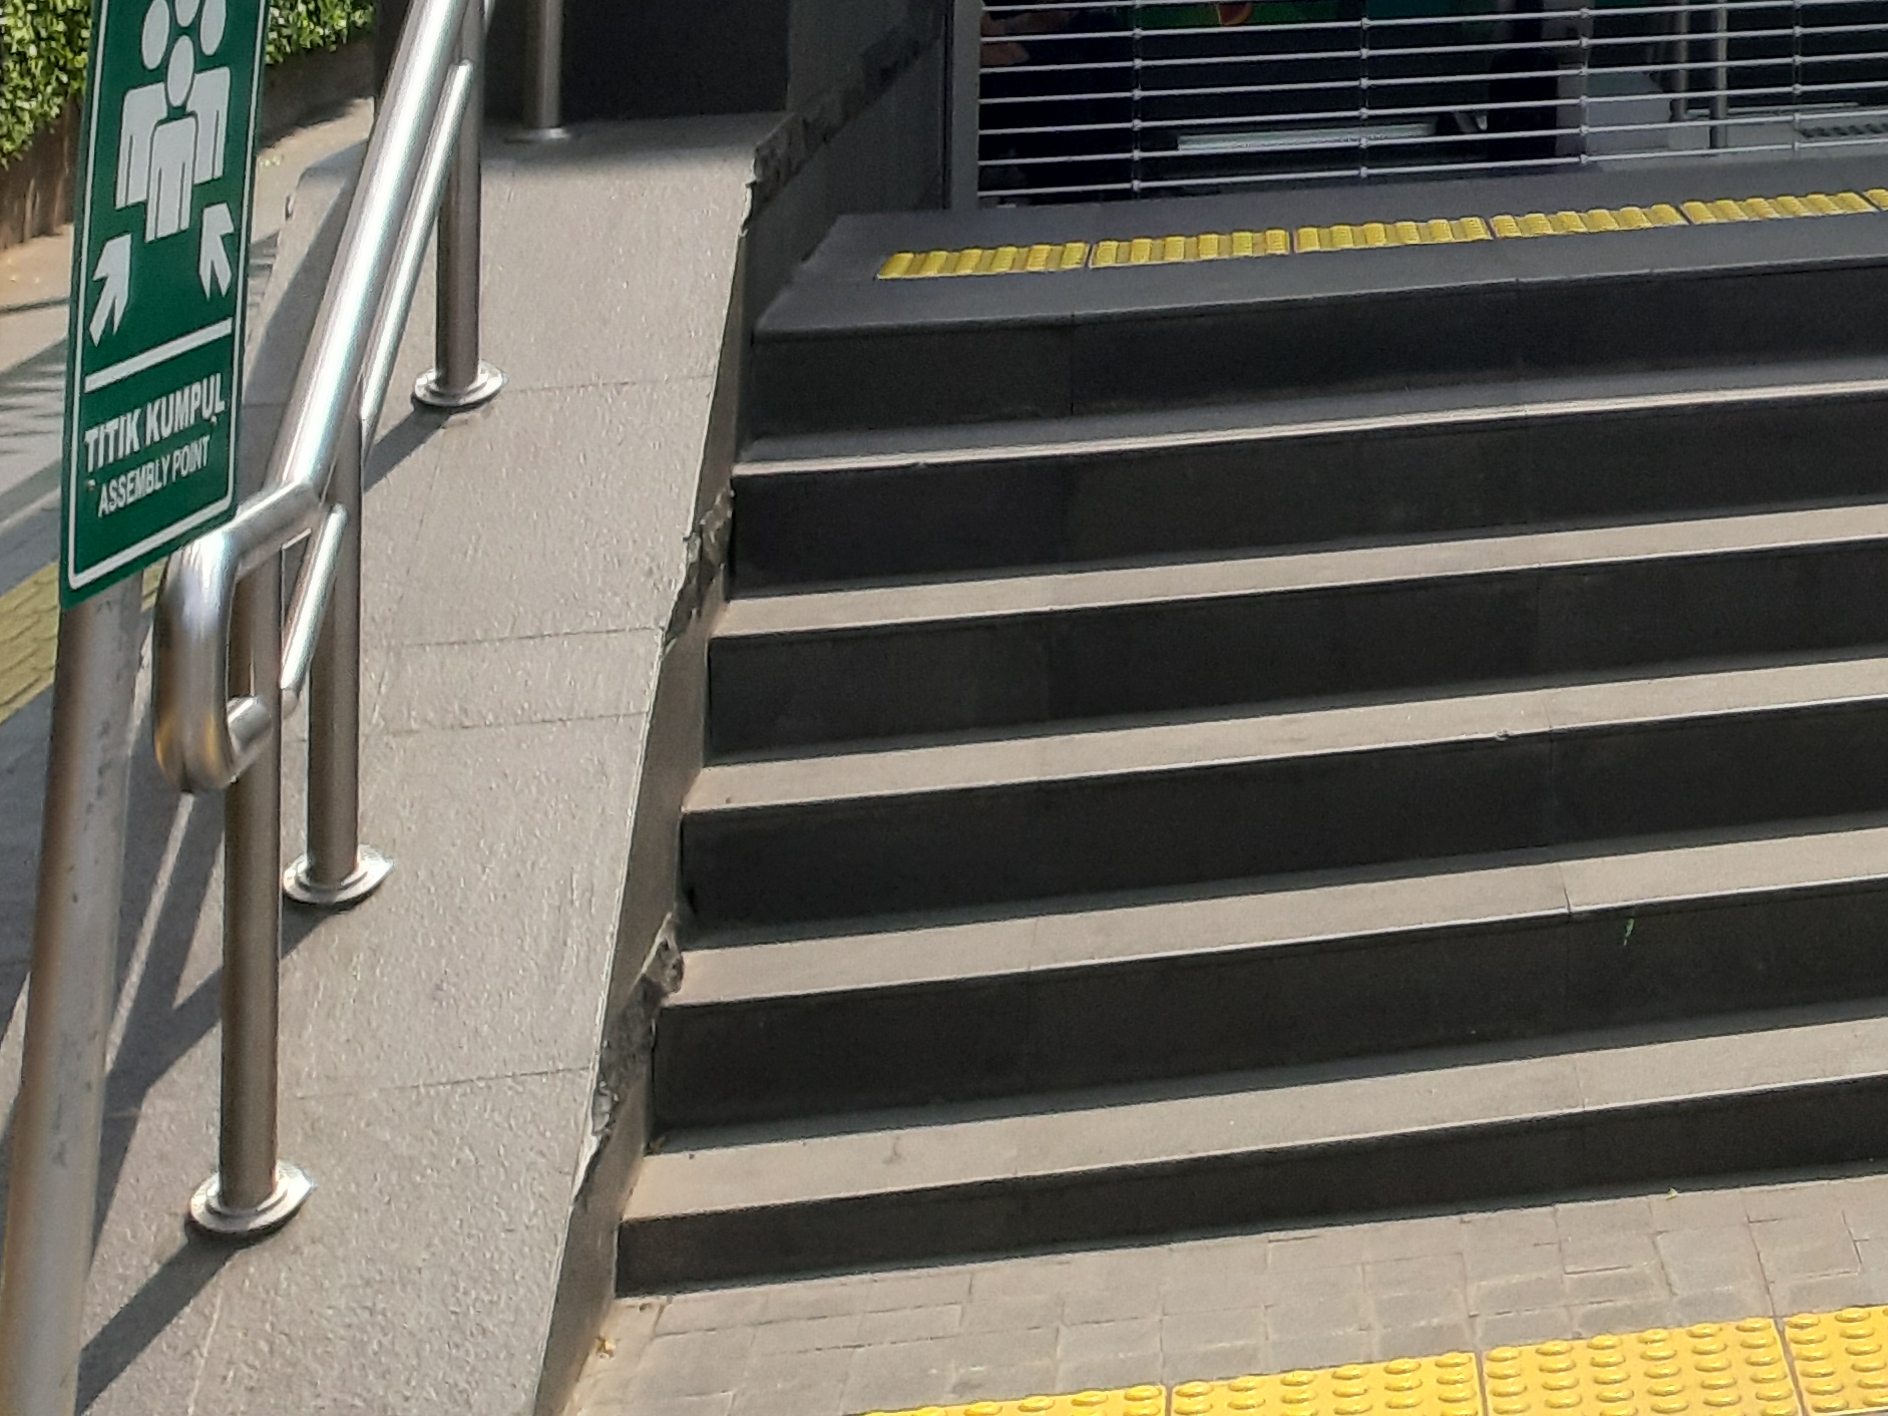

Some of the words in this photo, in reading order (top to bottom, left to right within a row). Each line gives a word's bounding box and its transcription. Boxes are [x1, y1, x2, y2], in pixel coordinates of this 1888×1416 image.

[84, 408, 142, 473] TITIK
[146, 372, 226, 447] KUMPUL
[98, 454, 171, 518] ASSEMBLY
[172, 434, 211, 483] POINT
